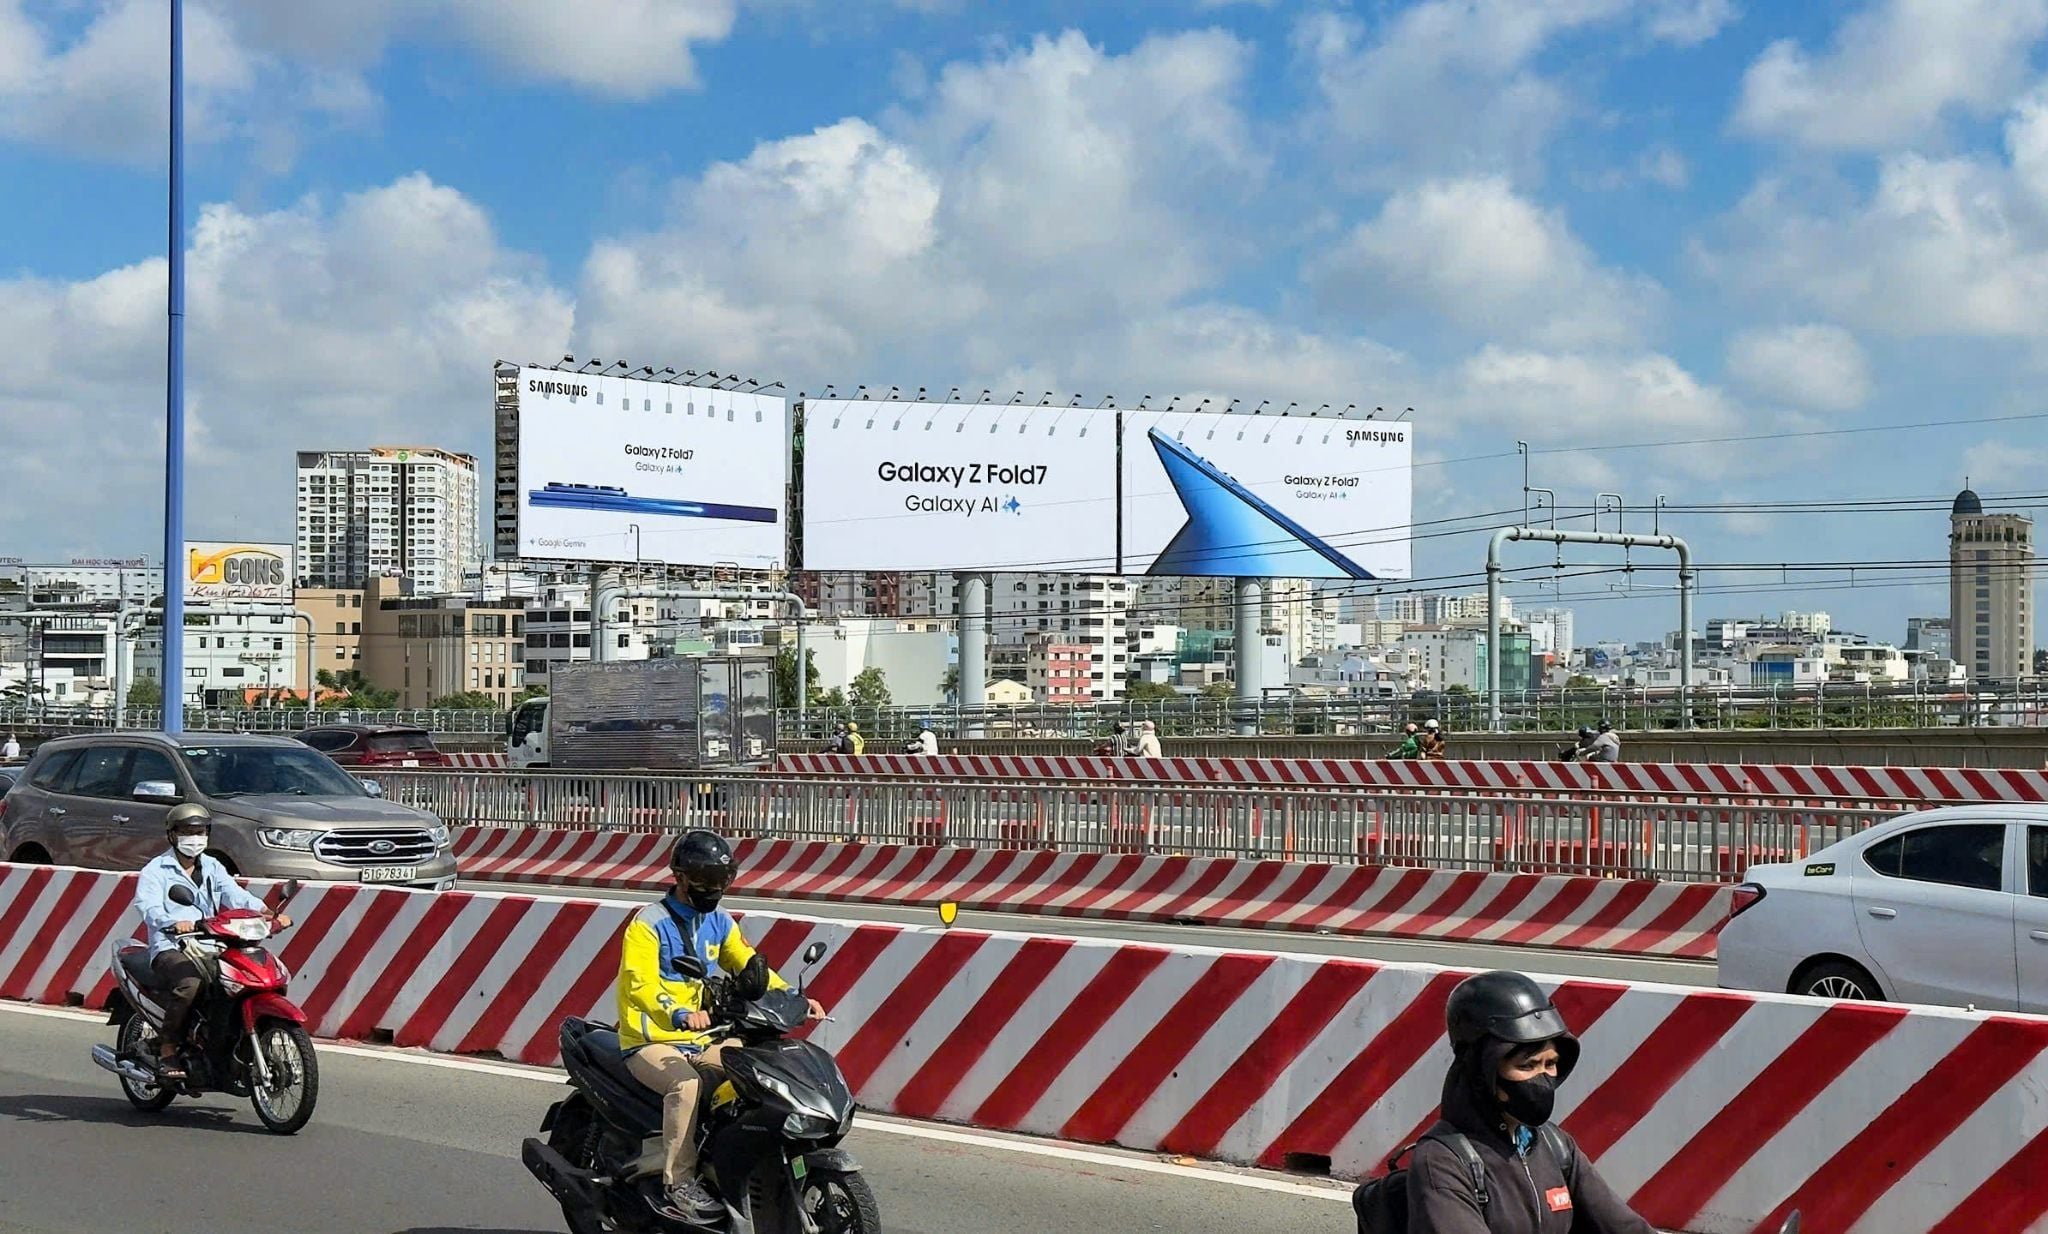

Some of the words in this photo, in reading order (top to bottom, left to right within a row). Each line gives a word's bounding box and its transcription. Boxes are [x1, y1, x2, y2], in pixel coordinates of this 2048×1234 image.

[529, 379, 588, 397] SAMSUNG
[1346, 430, 1404, 442] SAMSUNG
[624, 444, 660, 460] Galaxy
[661, 447, 667, 458] Z
[668, 448, 694, 460] Fold7
[635, 461, 665, 475] Galaxy
[666, 464, 674, 473] AI
[877, 461, 965, 489] Galaxy
[969, 463, 982, 483] Z
[987, 463, 1048, 485] Fold7
[1283, 474, 1323, 488] Galaxy
[1324, 476, 1330, 486] Z
[1332, 476, 1360, 487] Fold7
[1296, 490, 1327, 501] Galaxy
[1329, 491, 1338, 499] AI
[905, 494, 976, 517] Galaxy
[981, 496, 998, 512] AI
[538, 537, 562, 549] Google
